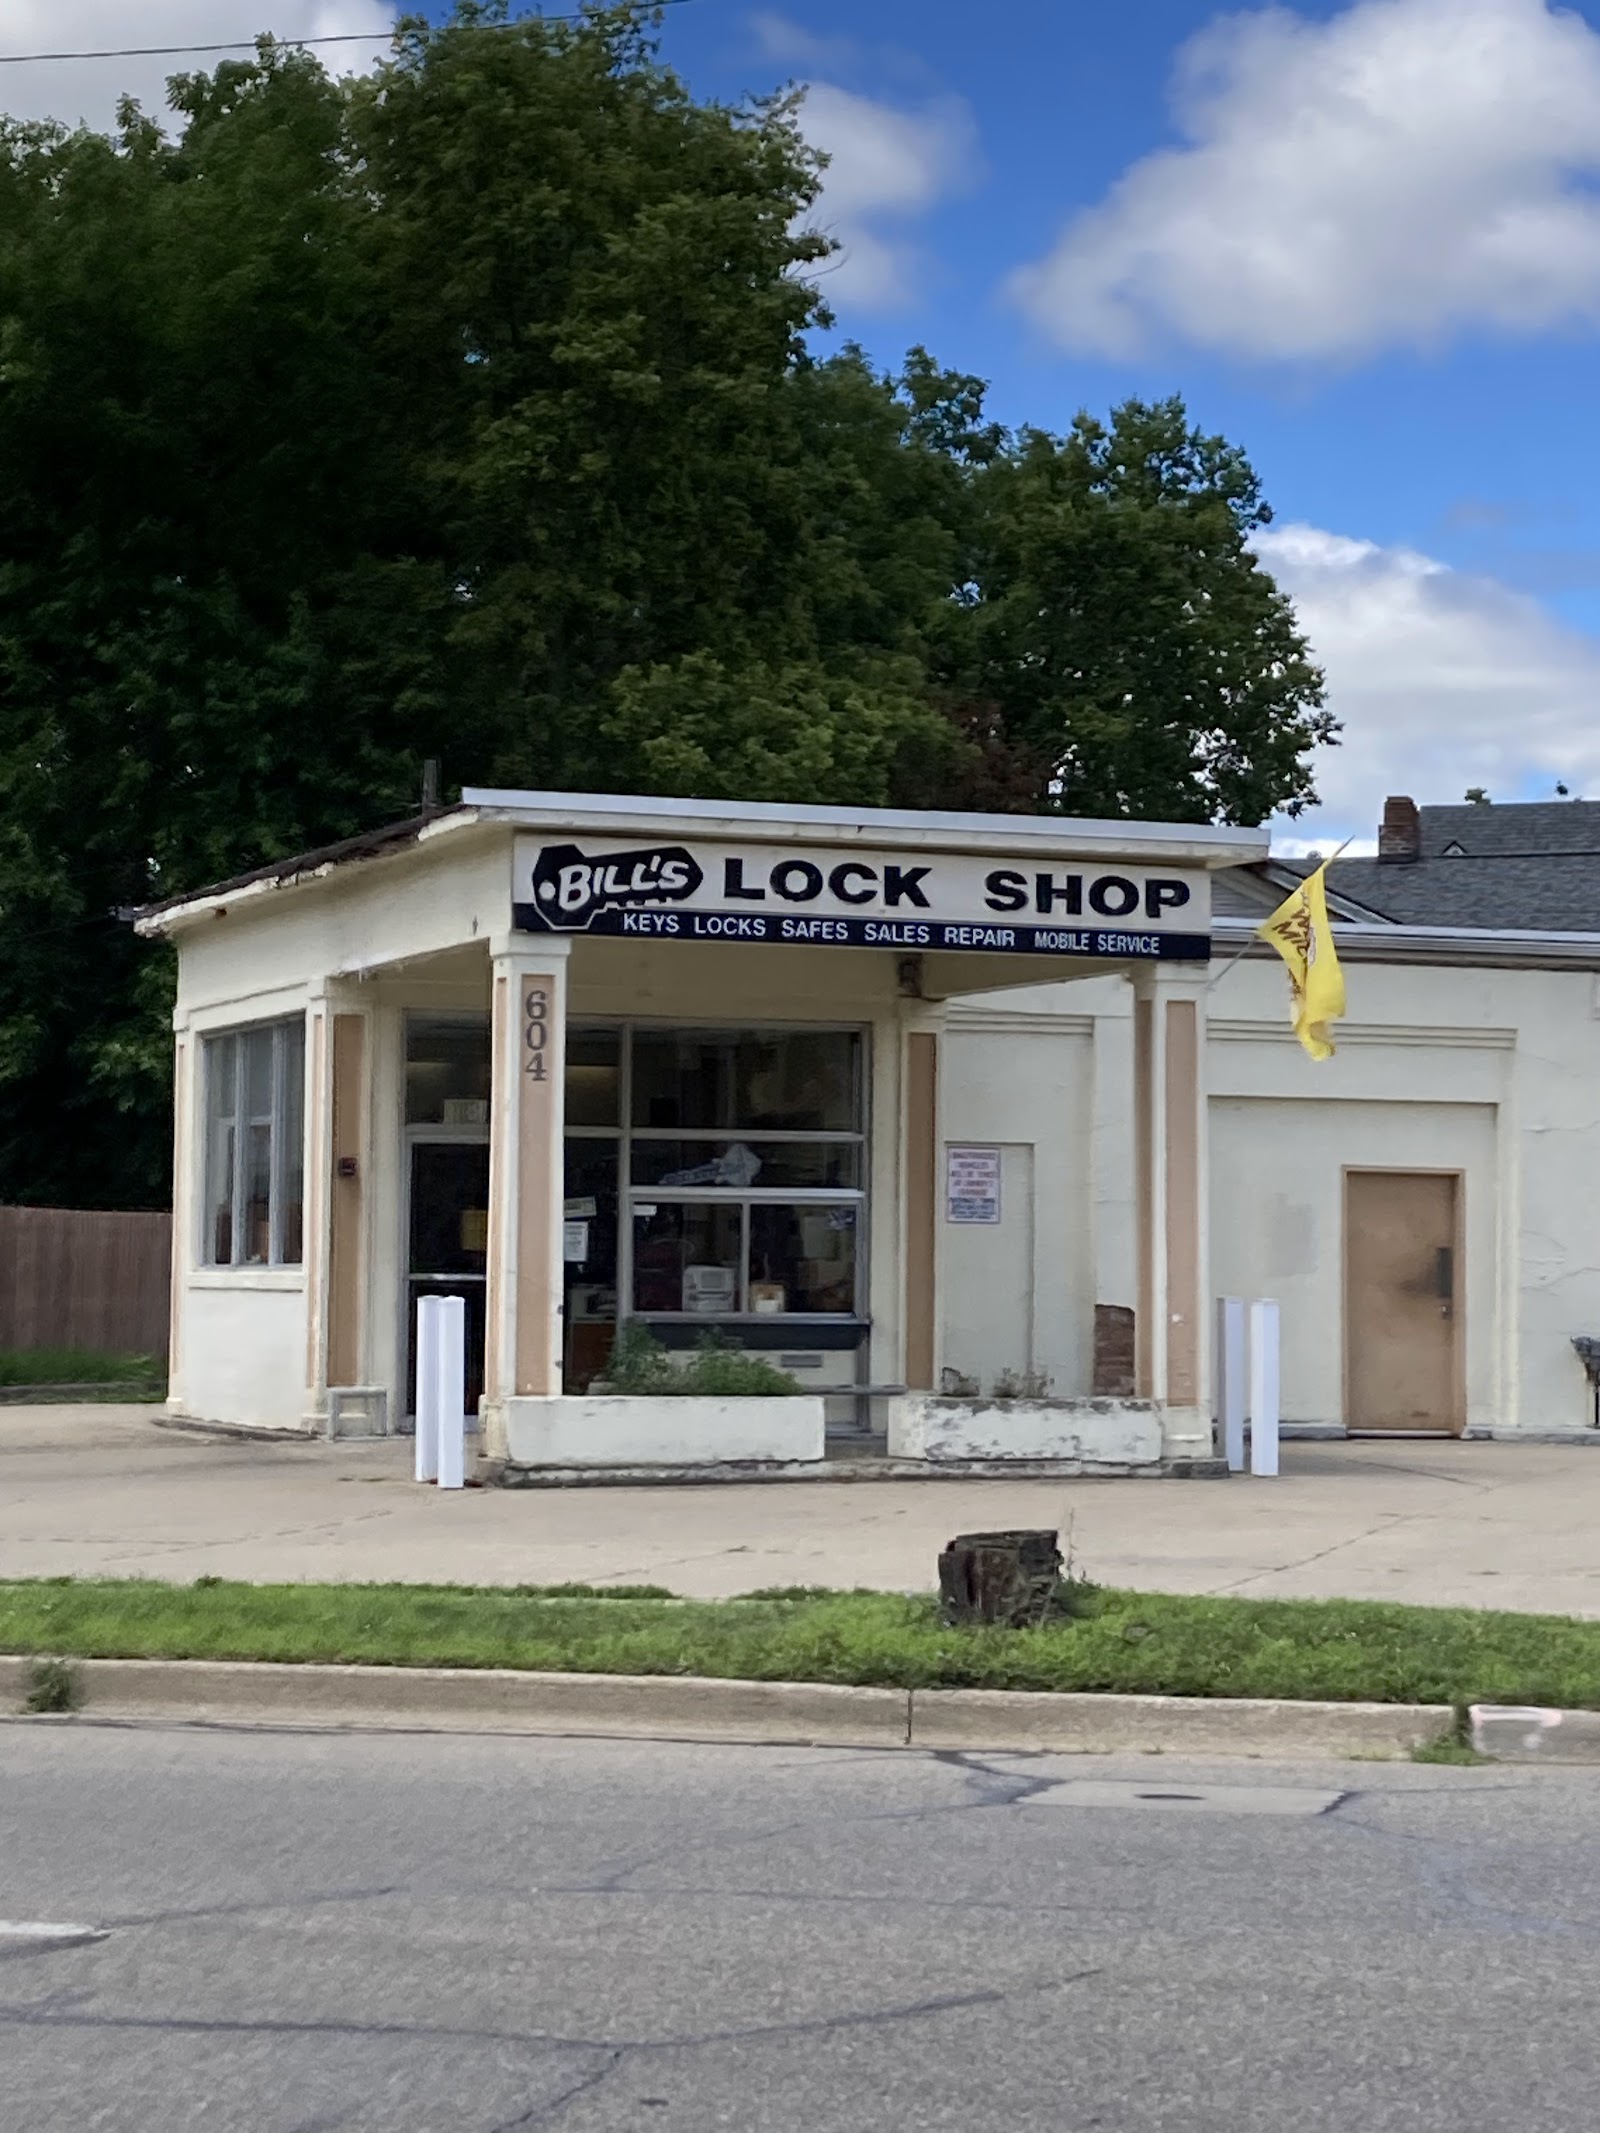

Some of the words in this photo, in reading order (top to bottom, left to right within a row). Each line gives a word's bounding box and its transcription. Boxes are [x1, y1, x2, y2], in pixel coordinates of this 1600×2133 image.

[558, 855, 689, 910] BILL'S
[724, 857, 932, 908] LOCK
[984, 870, 1190, 918] SHOP
[623, 913, 680, 932] KEYS
[694, 917, 766, 936] LOCKS
[781, 919, 848, 939] SAFES
[864, 923, 929, 943] SALES
[944, 927, 1015, 947] REPAIR
[1035, 931, 1090, 951] MOBILE
[1097, 934, 1160, 954] SERVICE
[525, 990, 547, 1081] 604
